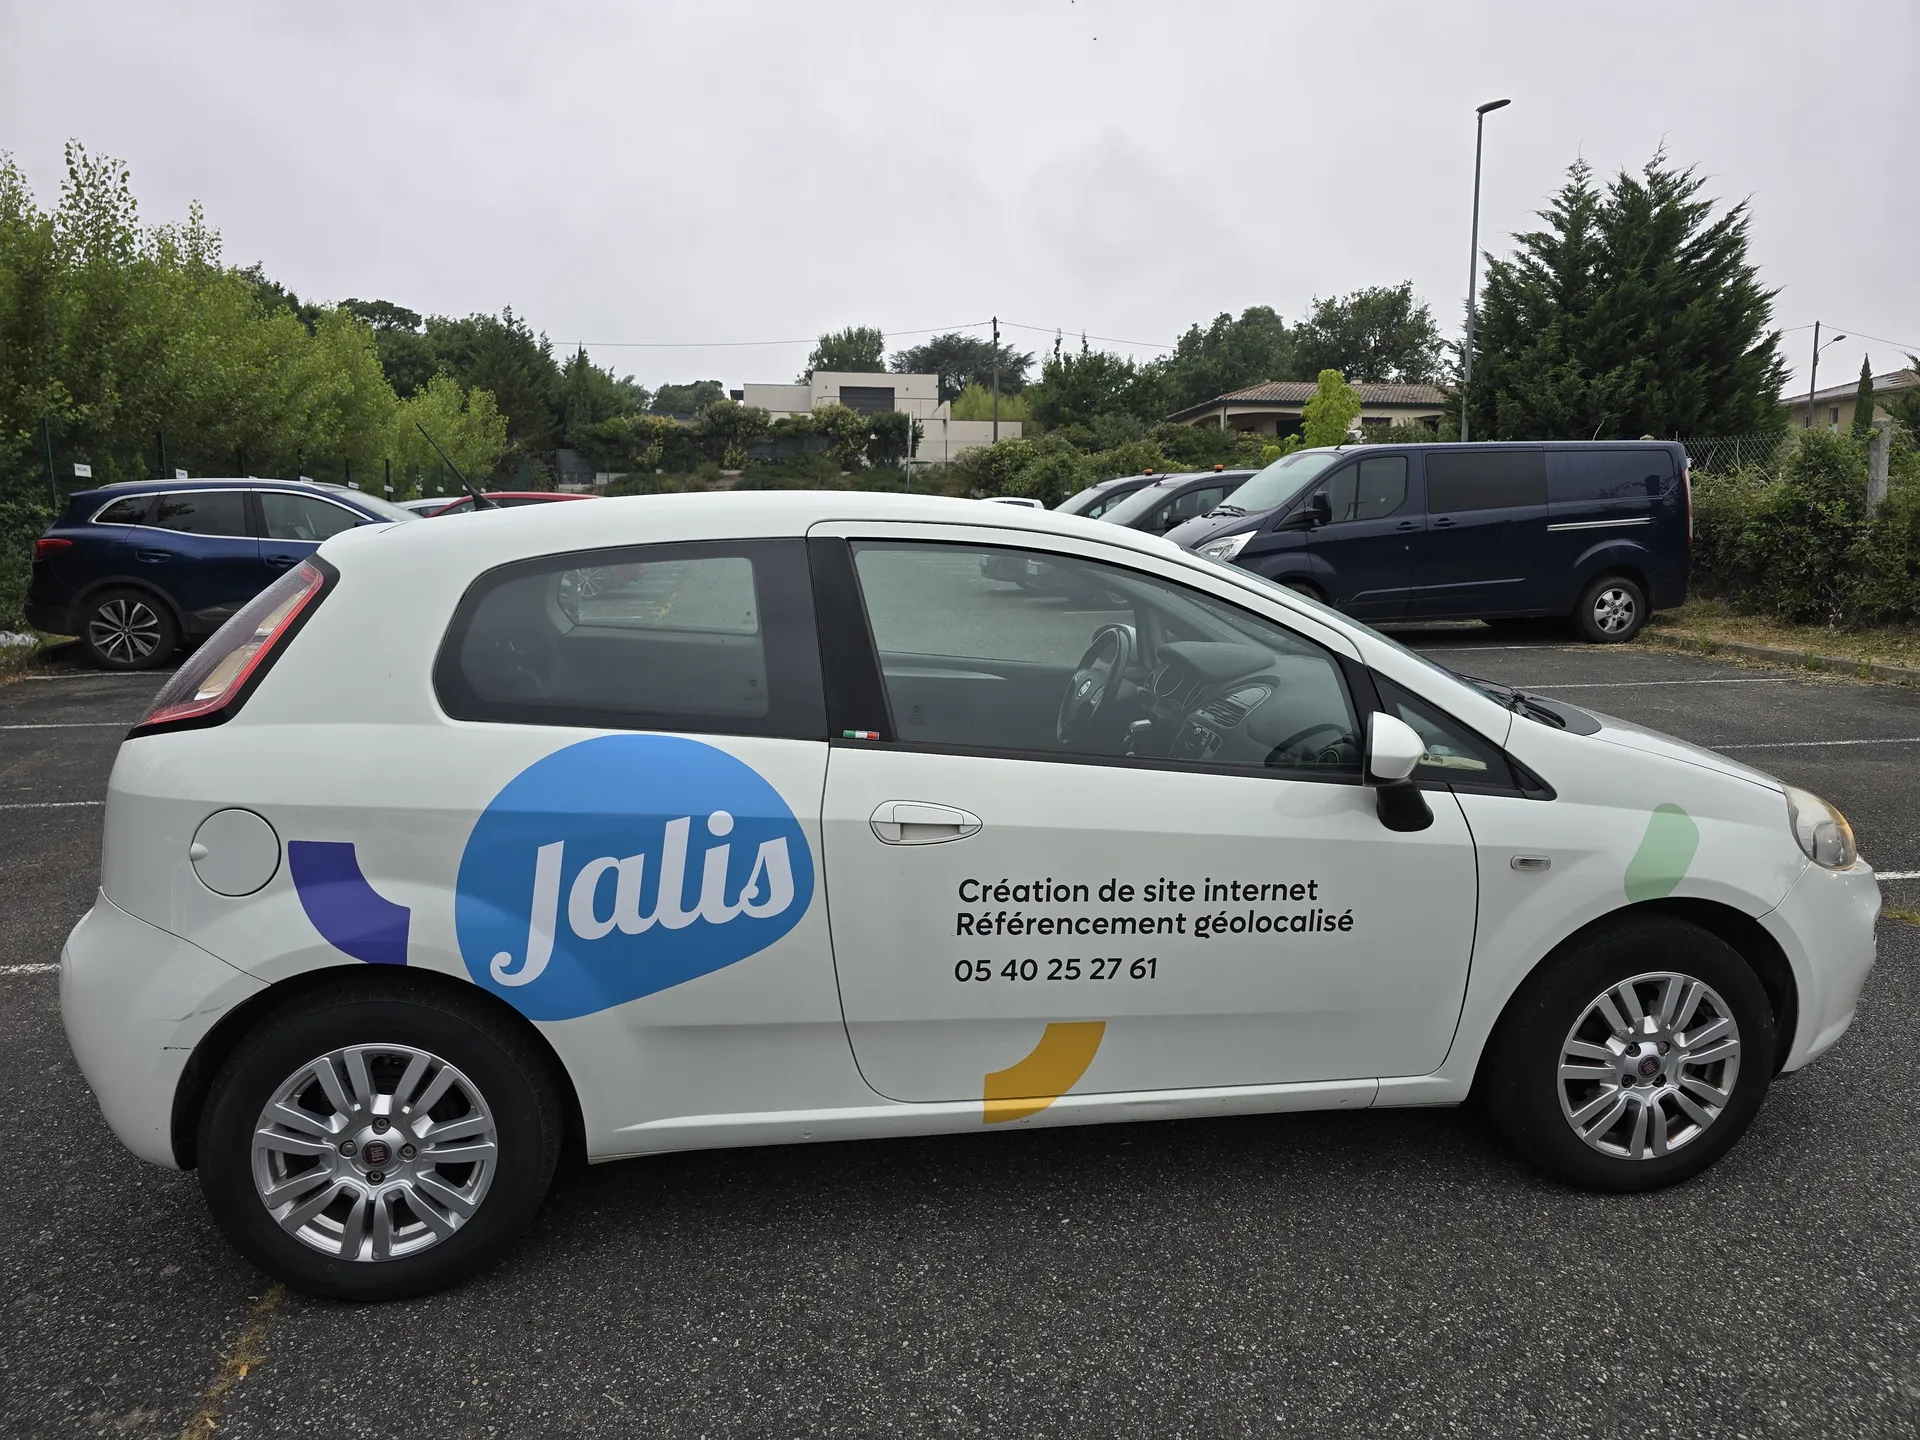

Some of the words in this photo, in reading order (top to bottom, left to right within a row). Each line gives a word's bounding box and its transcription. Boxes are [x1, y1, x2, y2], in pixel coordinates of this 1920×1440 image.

[490, 810, 794, 987] Jalis
[958, 877, 1089, 903] Création
[1098, 877, 1135, 903] de
[1143, 877, 1196, 903] site
[1204, 877, 1319, 902] internet
[957, 911, 1187, 936] Référencement
[1195, 908, 1354, 940] géolocalisé
[954, 959, 992, 983] 05
[1000, 959, 1039, 982] 40
[1046, 958, 1082, 981] 25
[1089, 957, 1123, 980] 27
[1129, 957, 1158, 980] 61
[371, 1146, 385, 1161] FIAT
